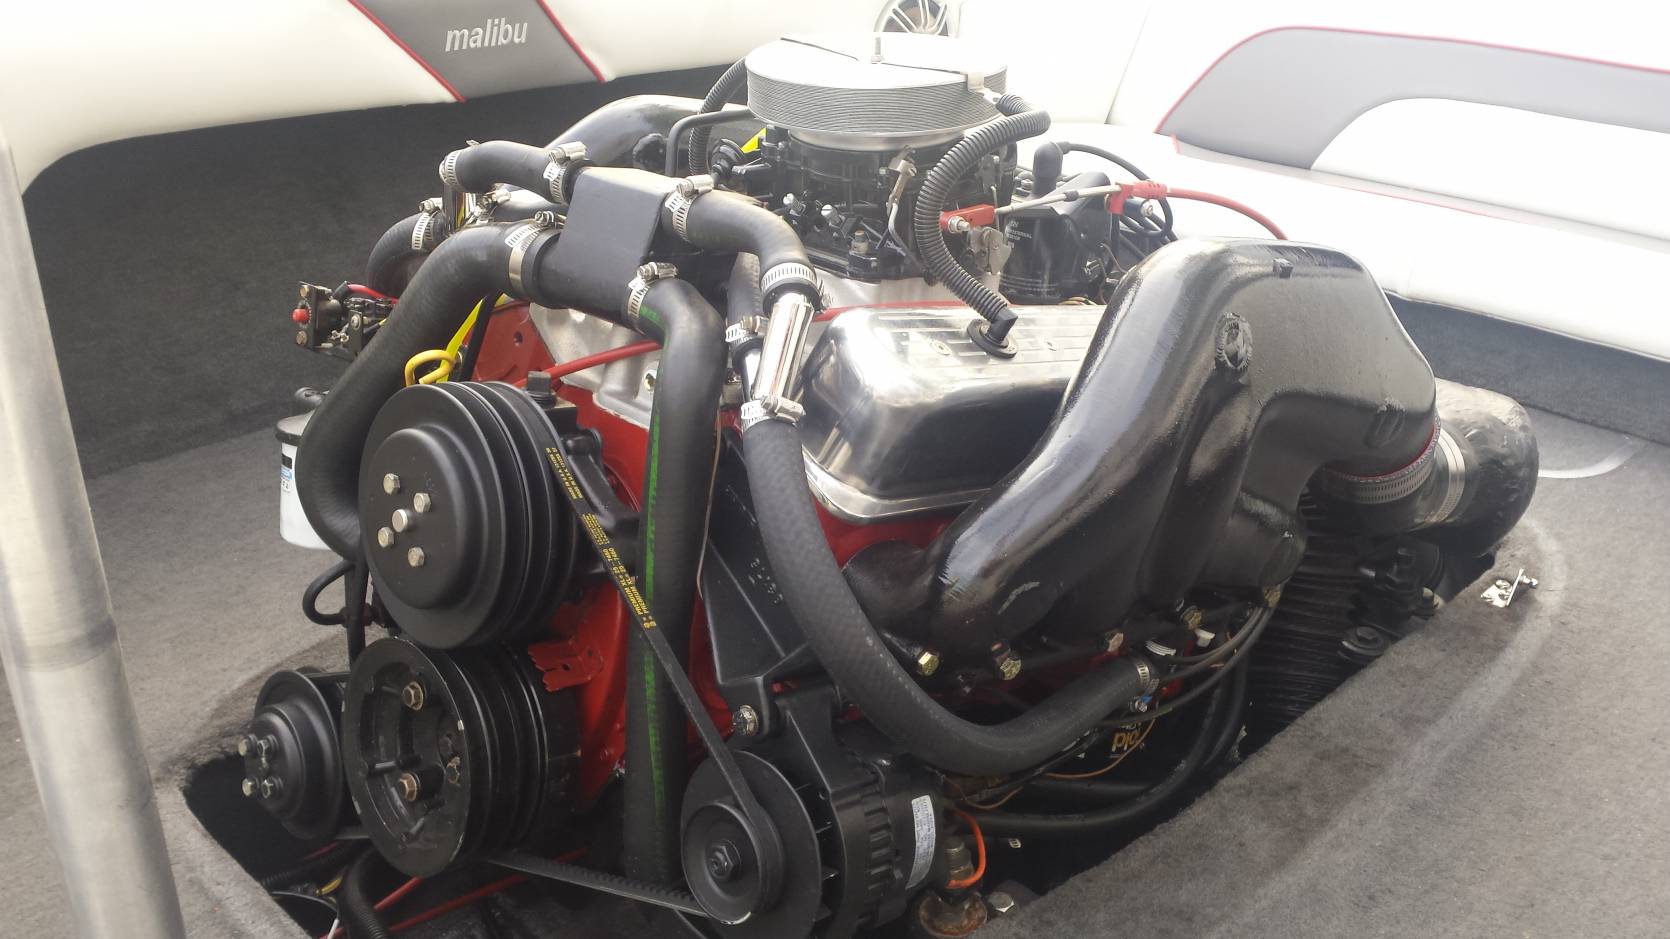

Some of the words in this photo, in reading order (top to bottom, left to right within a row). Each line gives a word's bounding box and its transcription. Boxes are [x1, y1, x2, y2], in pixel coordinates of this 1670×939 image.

[445, 17, 529, 52] malibu
[624, 588, 643, 614] PREMIUM
[630, 587, 649, 614] PREMIUM
